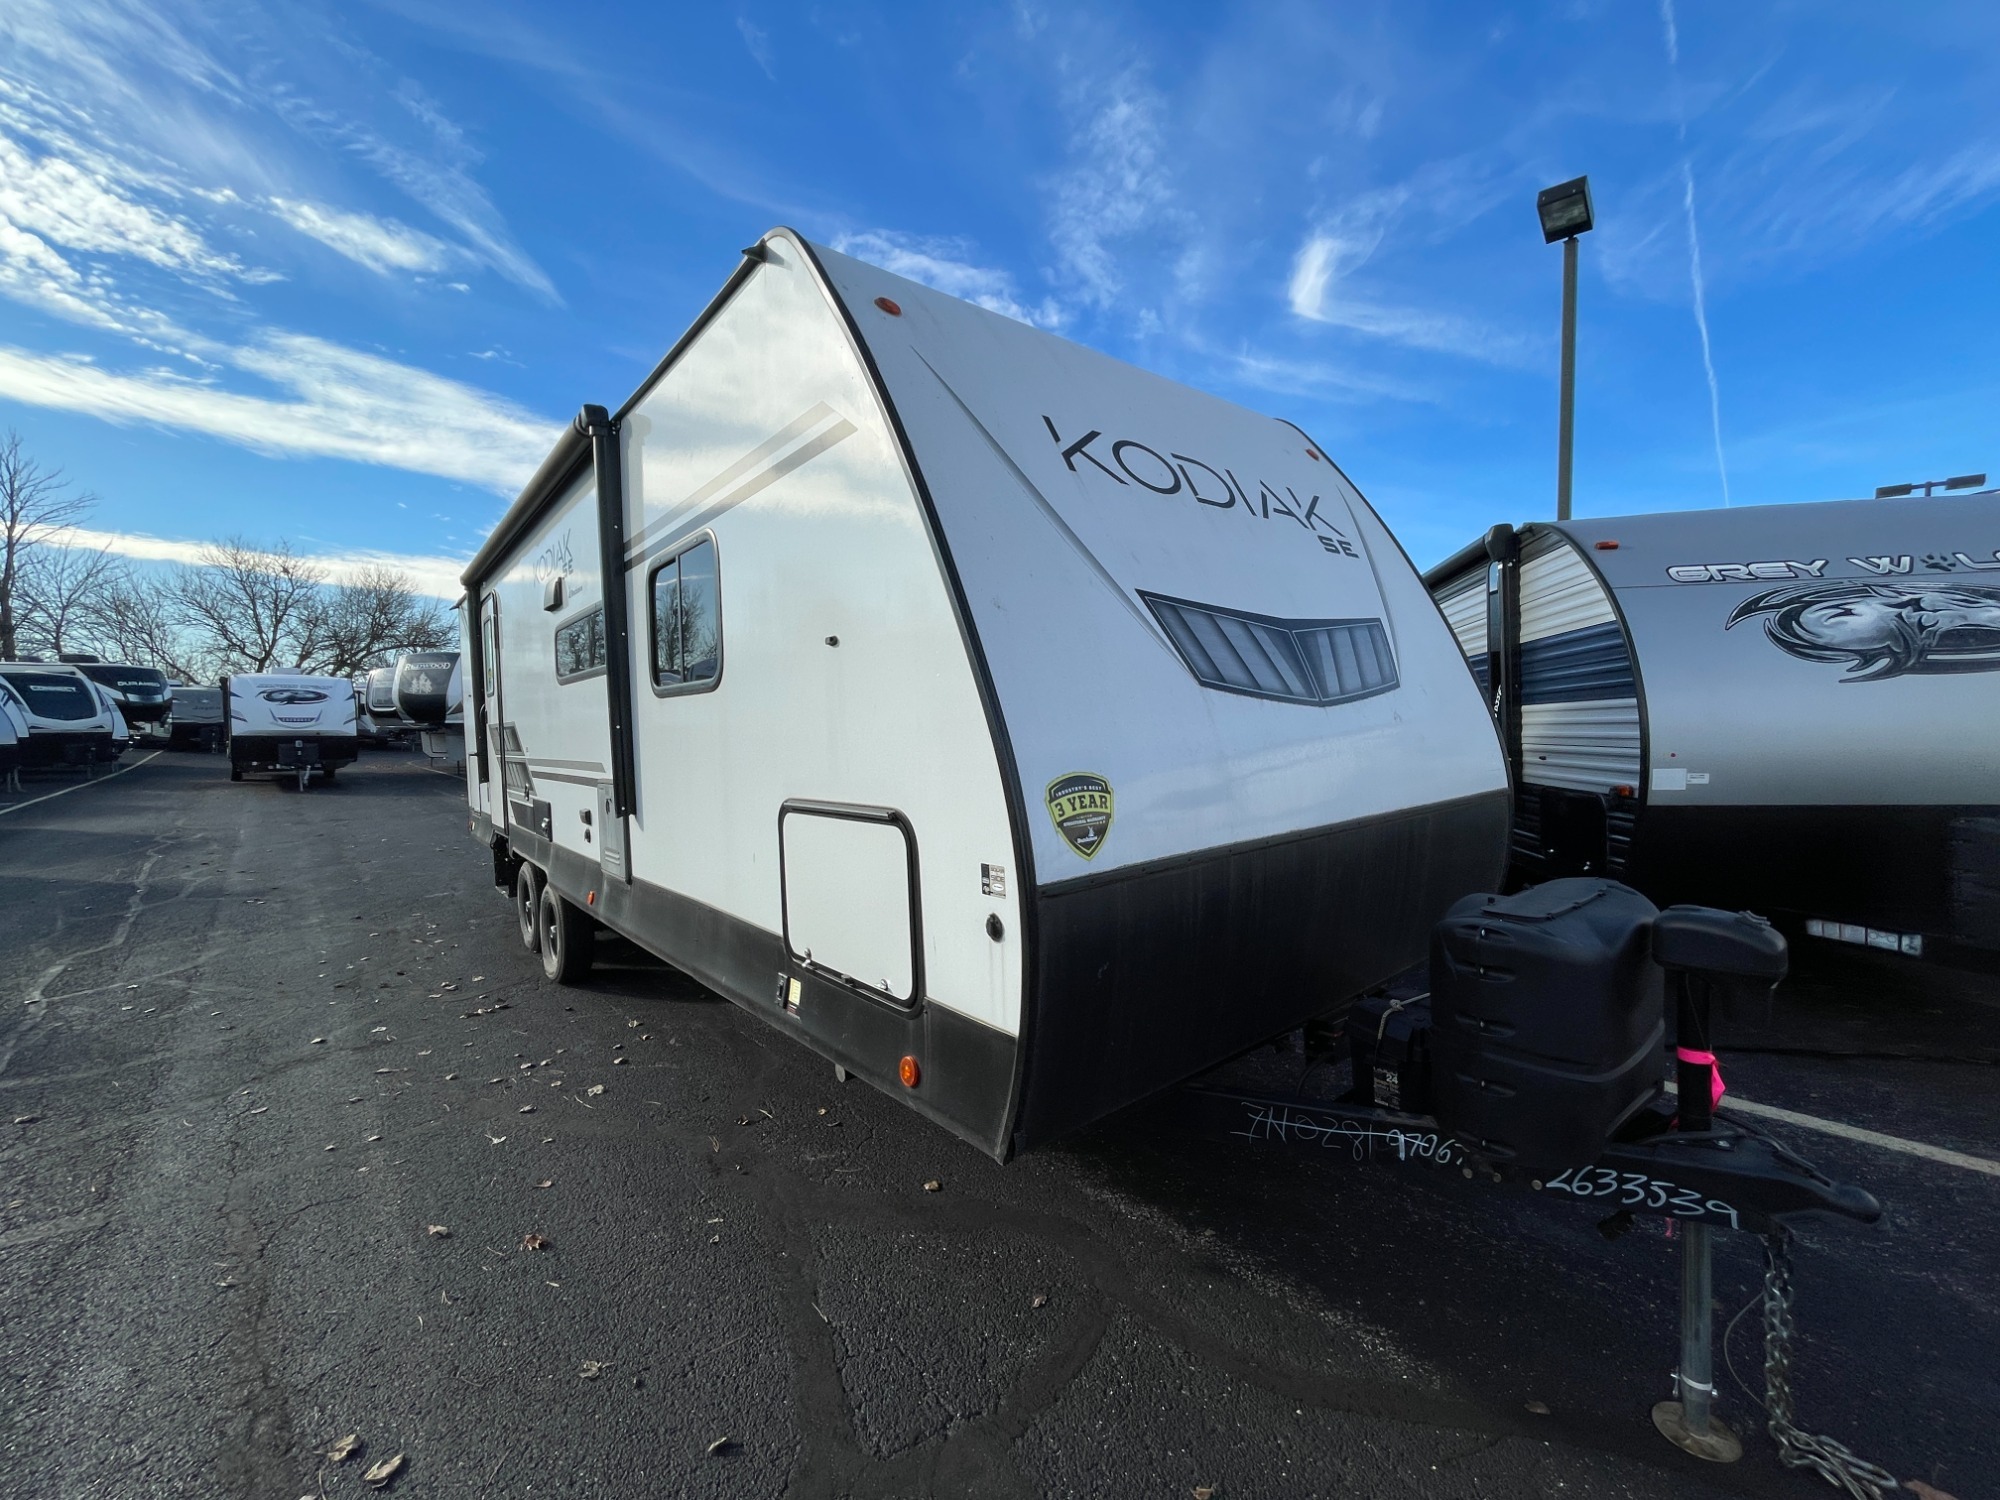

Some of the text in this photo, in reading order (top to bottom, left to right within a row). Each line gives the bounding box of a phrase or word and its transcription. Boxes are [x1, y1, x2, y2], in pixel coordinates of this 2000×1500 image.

[1042, 415, 1346, 538] KODIAK
[1318, 535, 1360, 559] SE
[1665, 558, 1829, 583] GREY
[1054, 794, 1109, 818] 3 YEAR
